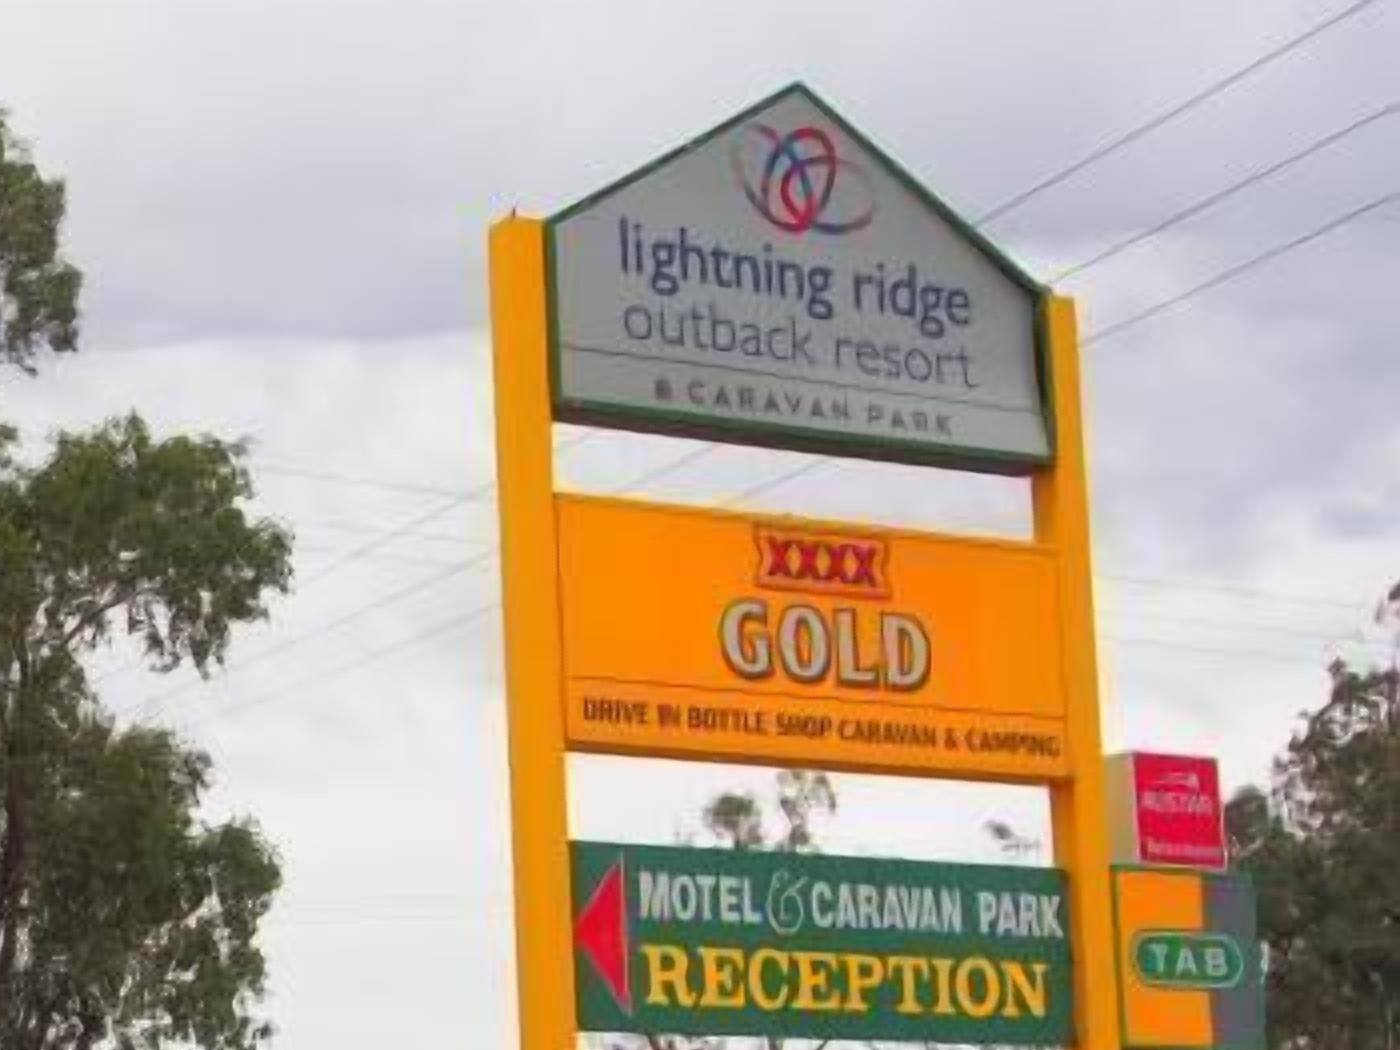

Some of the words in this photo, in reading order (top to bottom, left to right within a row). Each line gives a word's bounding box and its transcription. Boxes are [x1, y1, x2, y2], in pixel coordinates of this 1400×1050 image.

[617, 217, 834, 320] lightning
[852, 263, 971, 338] ridge
[623, 302, 810, 363] outback
[833, 334, 979, 388] resort
[686, 378, 851, 421] CARAVAN
[865, 399, 952, 436] PARK
[766, 535, 878, 588] XXXX
[718, 596, 931, 693] GOLD
[582, 696, 649, 726] DRIVE
[686, 703, 769, 736] BOTTLE
[775, 711, 833, 739] SHOP
[838, 718, 937, 749] CARAVAN
[964, 727, 1061, 760] CAMPING
[638, 870, 762, 926] MOTEL
[811, 880, 963, 933] CARAVAN
[977, 891, 1065, 939] PARK
[640, 943, 1050, 1020] RECEPTION
[1146, 943, 1229, 977] TAB
